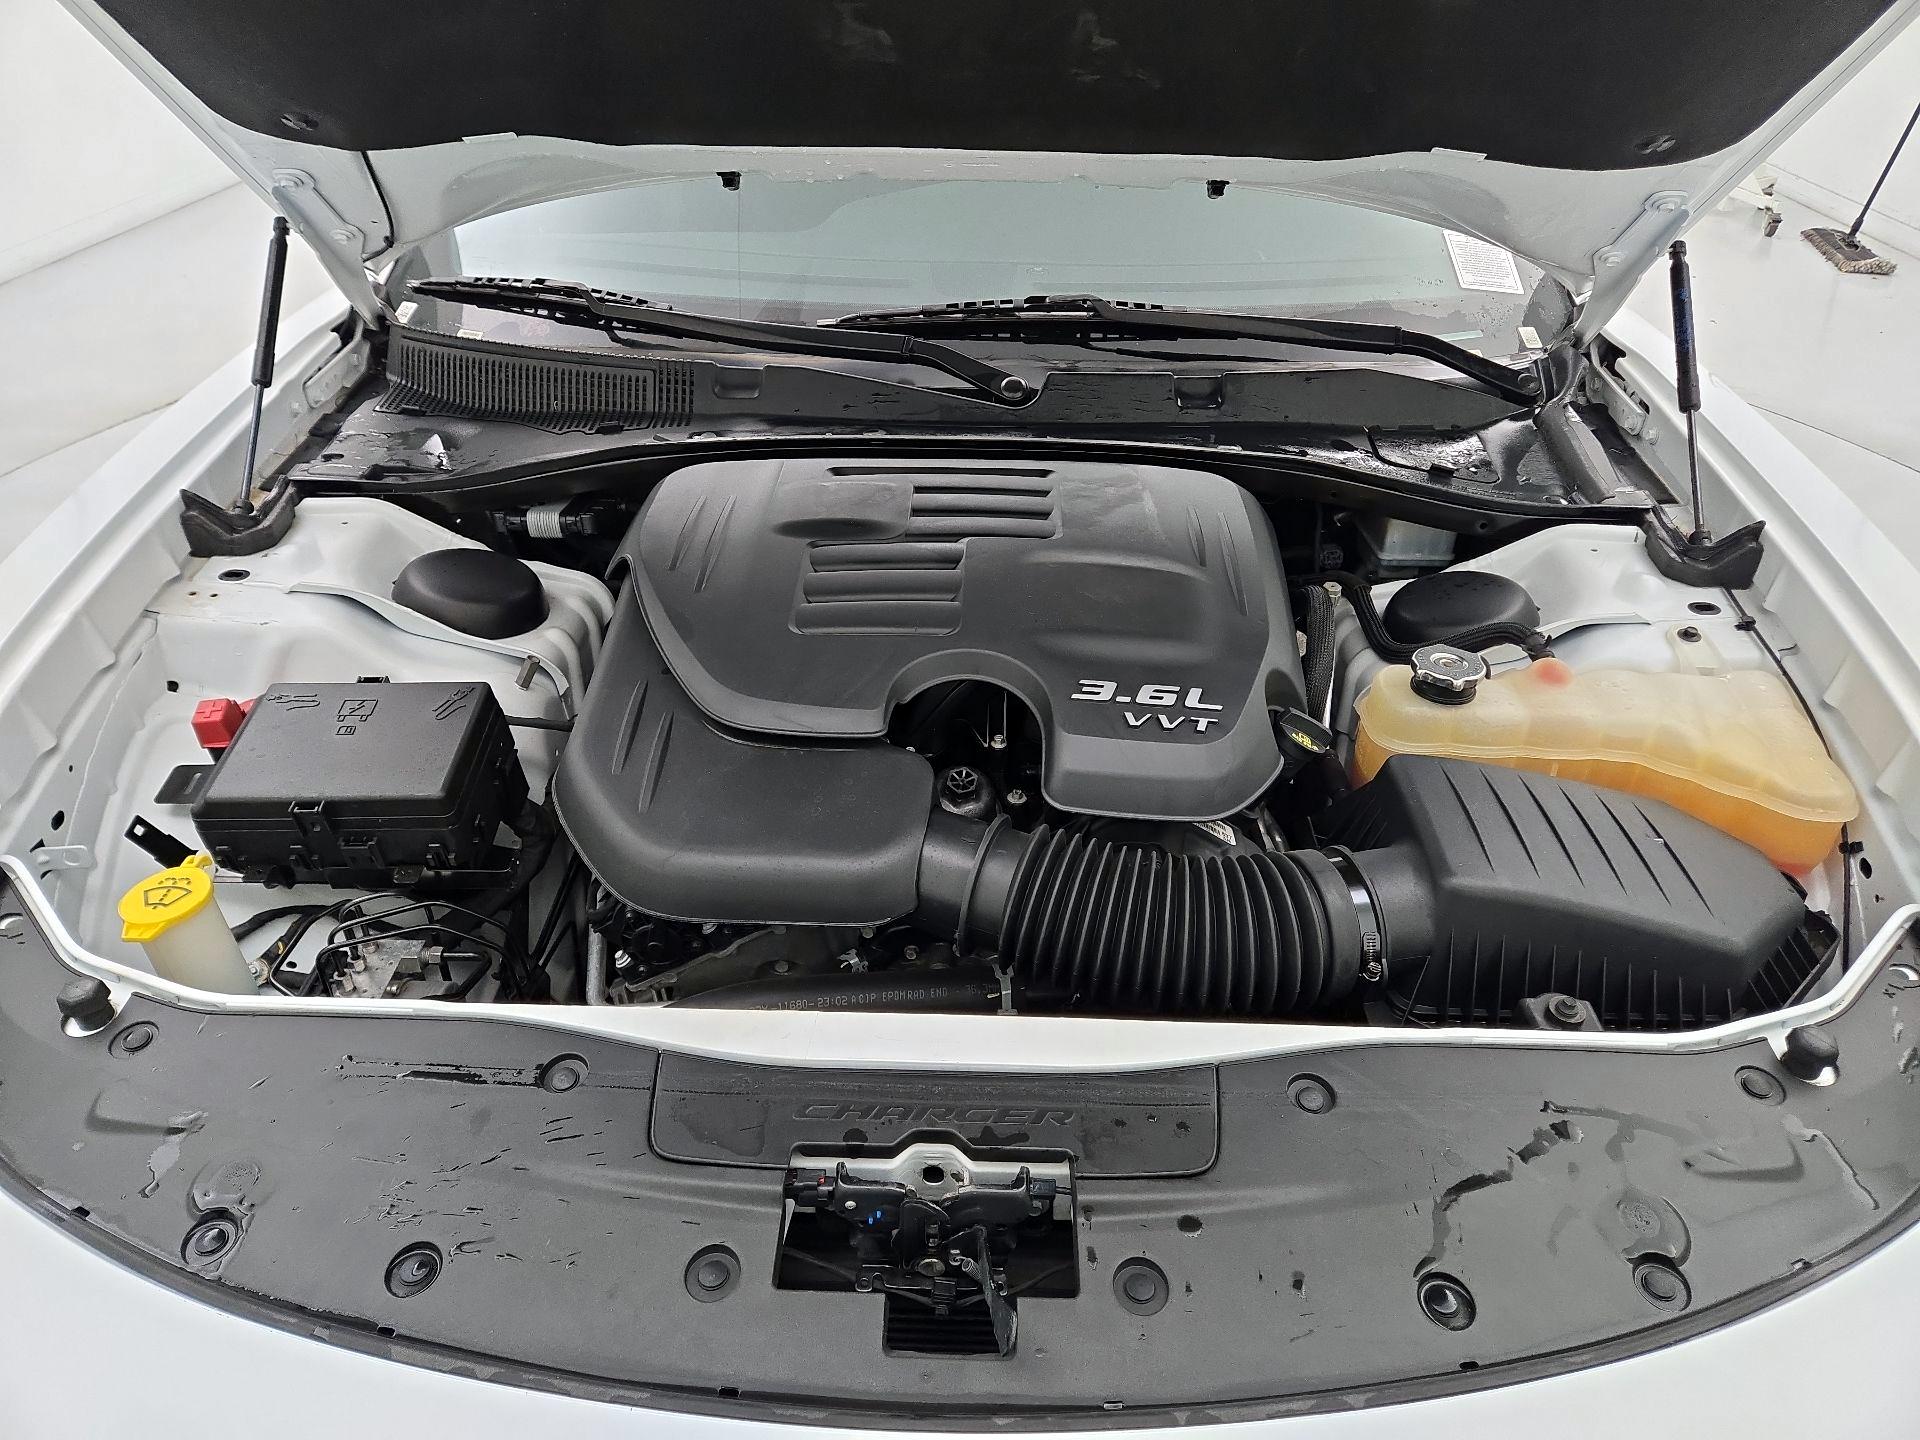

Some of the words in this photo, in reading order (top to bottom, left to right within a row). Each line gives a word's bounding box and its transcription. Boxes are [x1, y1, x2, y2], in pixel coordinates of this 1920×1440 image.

[1071, 679, 1223, 711] 3.6L
[1123, 711, 1219, 733] VVT
[792, 1104, 1075, 1127] CHARGER
